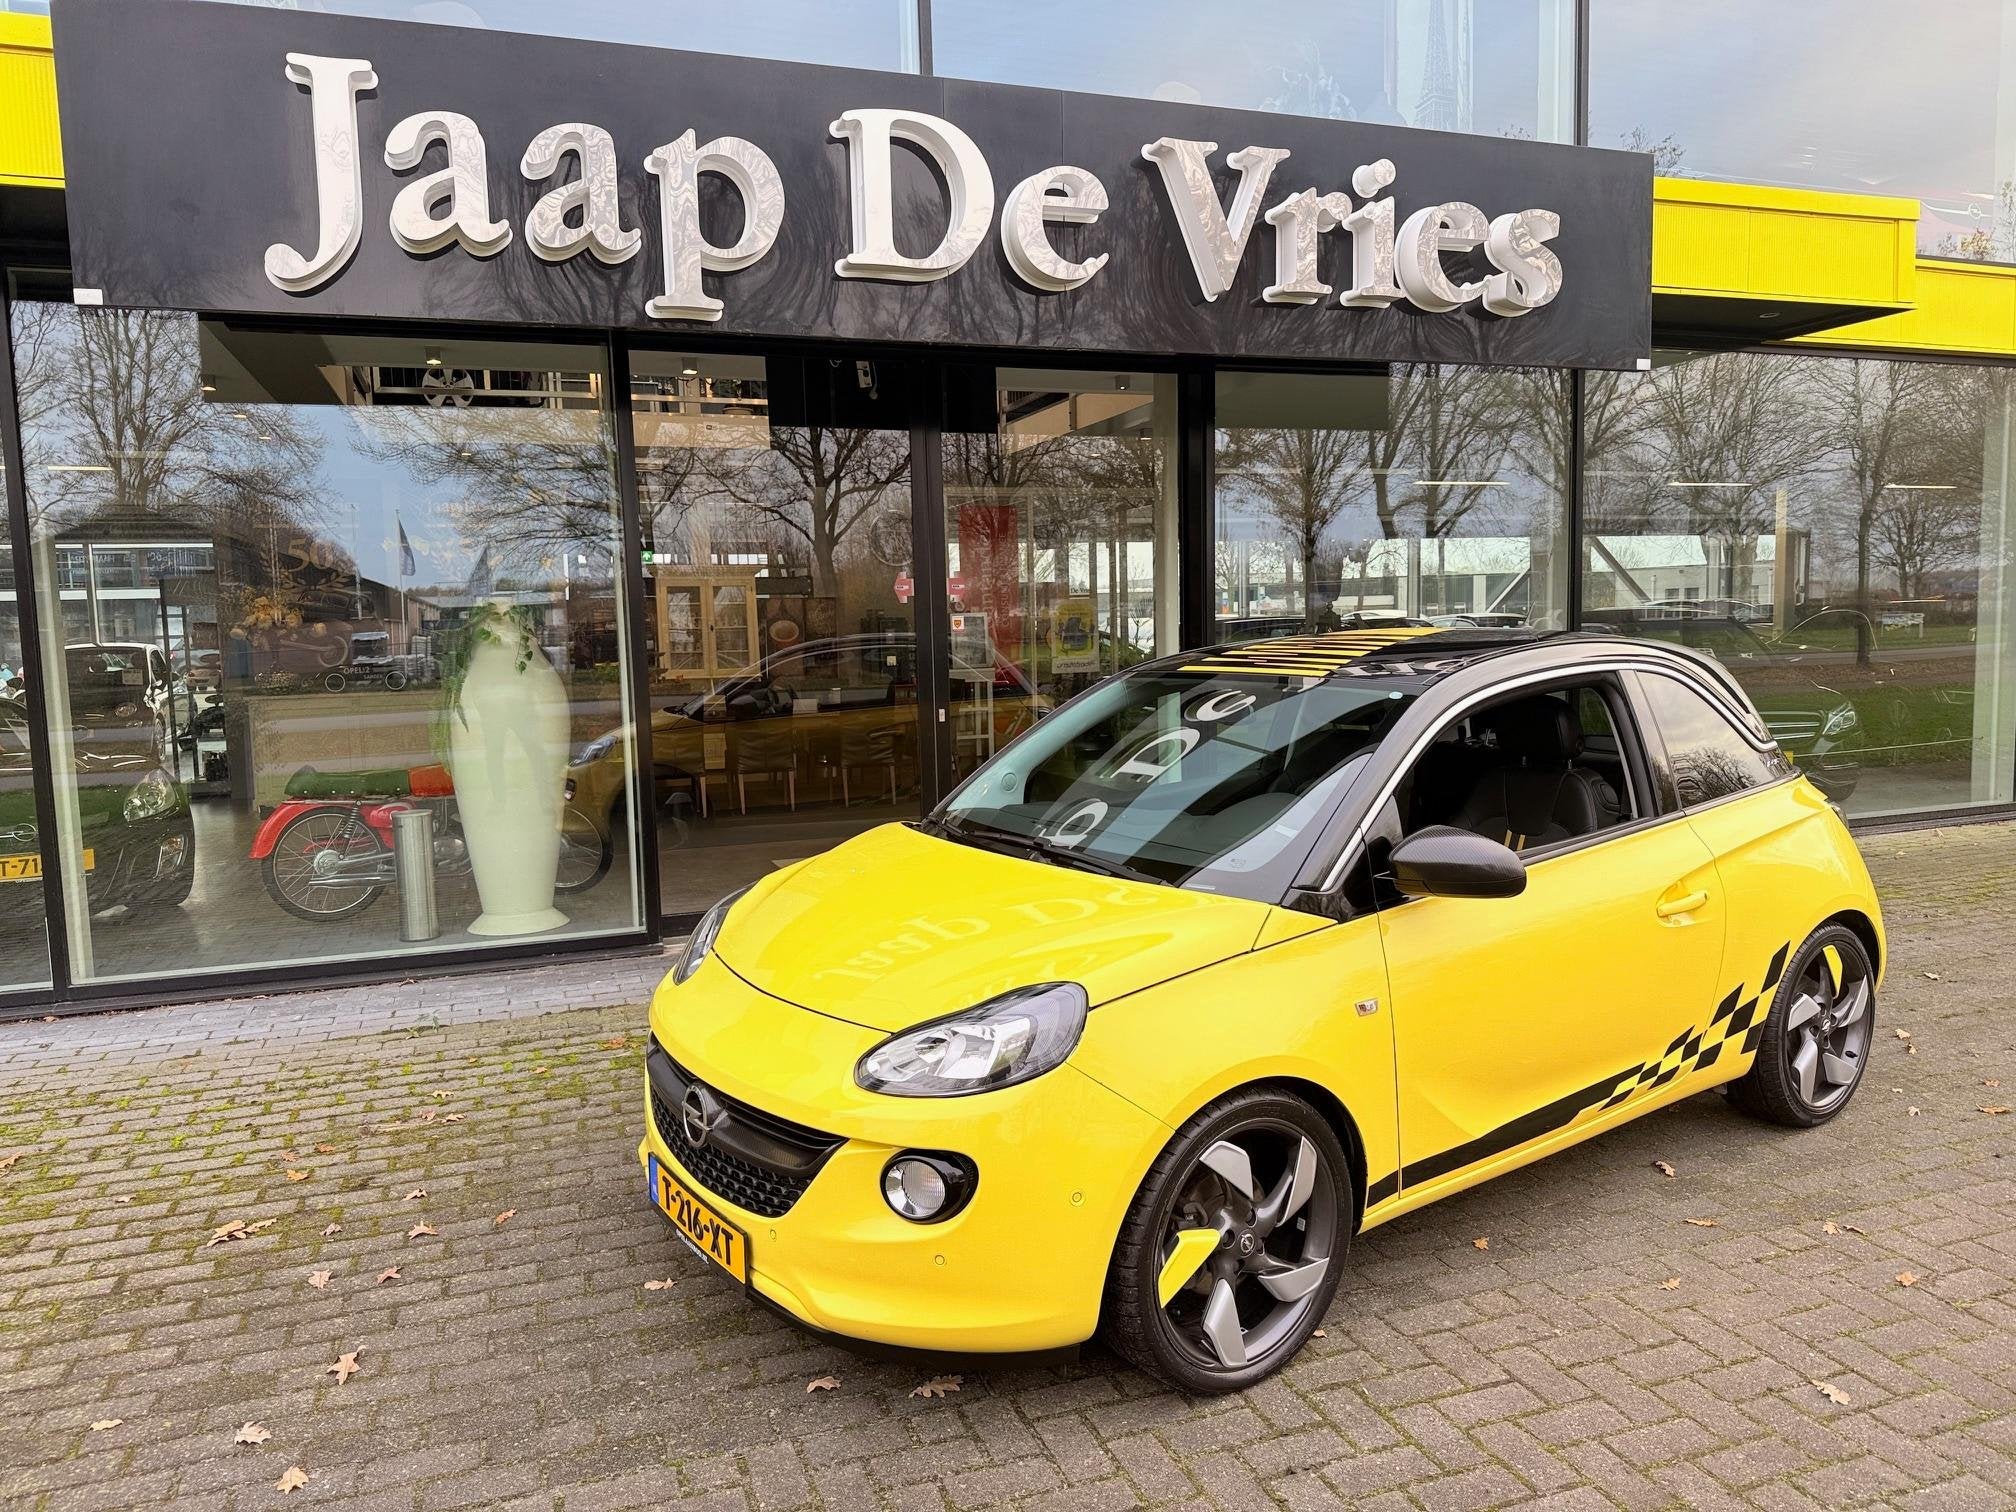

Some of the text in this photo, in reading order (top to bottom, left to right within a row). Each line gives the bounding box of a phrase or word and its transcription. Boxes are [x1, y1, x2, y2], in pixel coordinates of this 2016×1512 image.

[264, 52, 1563, 322] Jaap De Vries
[662, 1175, 734, 1265] T-216-XT
